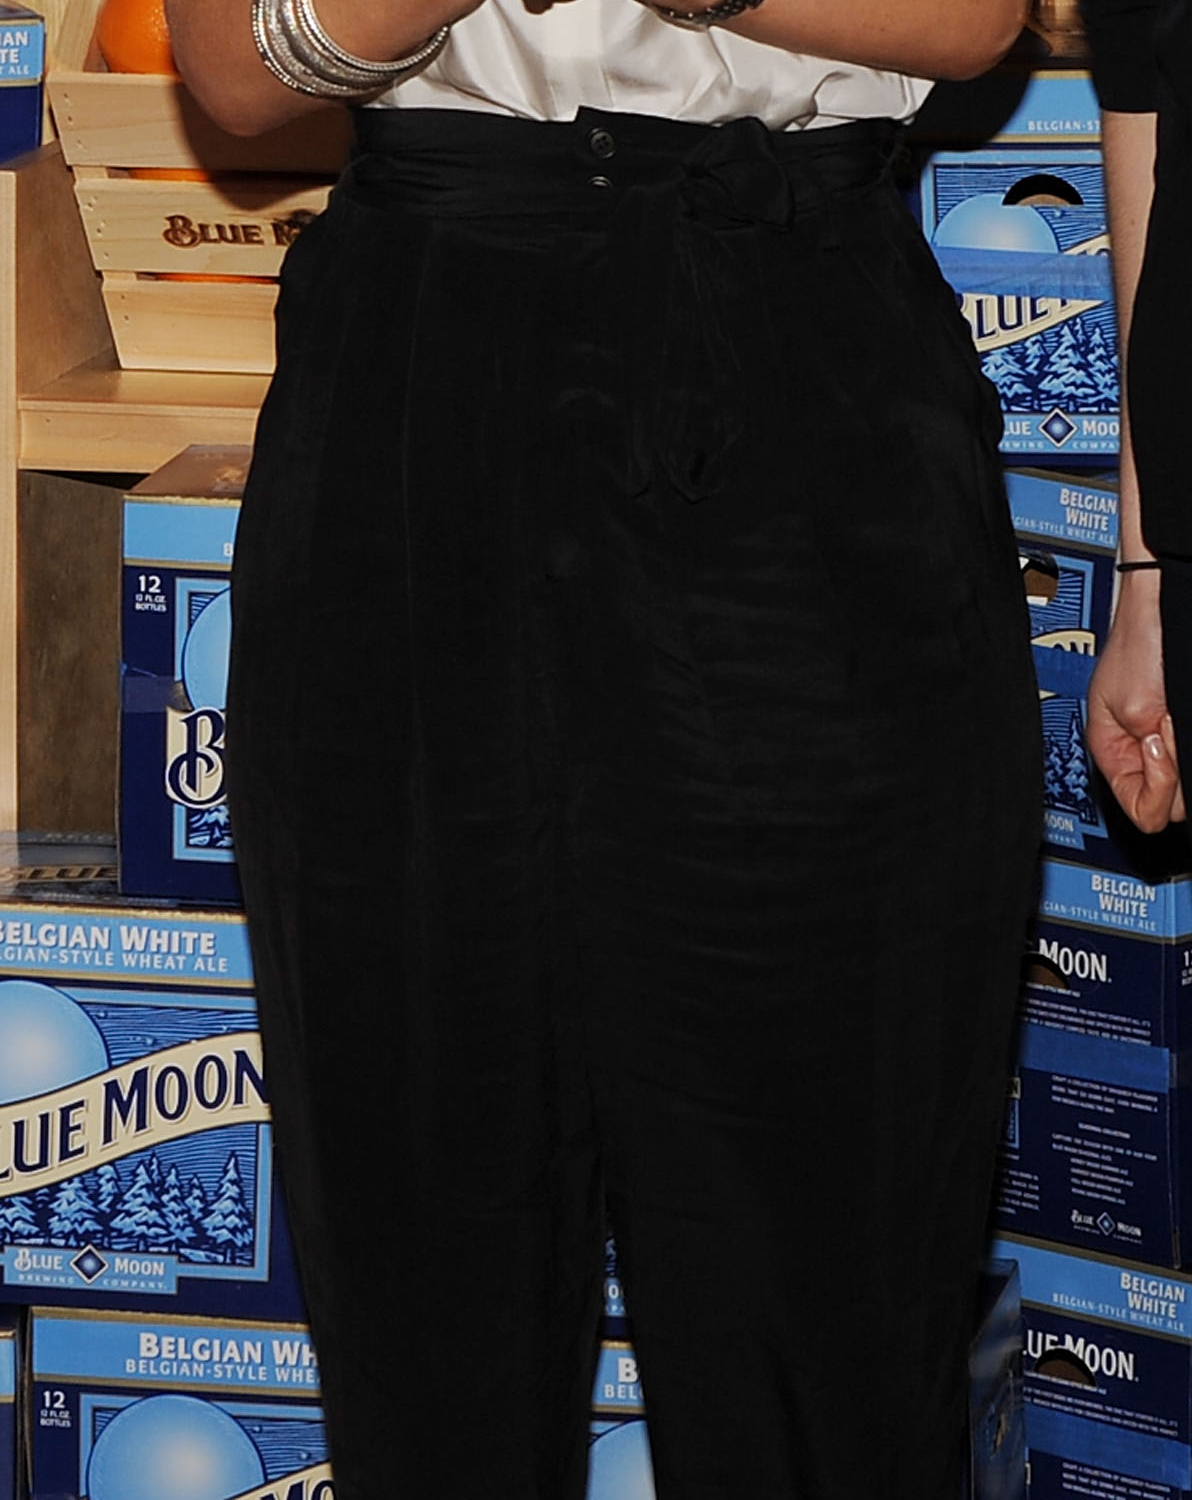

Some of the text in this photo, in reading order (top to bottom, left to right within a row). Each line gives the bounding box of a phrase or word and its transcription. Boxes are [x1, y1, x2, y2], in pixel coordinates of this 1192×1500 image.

[1027, 119, 1100, 132] BELGIAN-ST
[164, 214, 263, 248] BLUE
[975, 295, 1049, 340] LUE
[1083, 420, 1119, 436] MOO
[1060, 488, 1117, 514] BELGIAN
[1015, 516, 1064, 535] GIAN-STYLE
[1066, 508, 1109, 531] WHITE
[139, 575, 161, 593] 12
[1091, 874, 1156, 902] BELGIAN
[1044, 901, 1099, 920] GIAN-STYLE
[1099, 893, 1148, 918] WHITE
[120, 925, 216, 955] WHITE
[0, 946, 228, 973] GIAN-STYLE WHEAT ALE
[0, 1049, 269, 1178] UE MOON
[14, 1247, 164, 1276] BLUE MOON
[18, 1274, 75, 1285] BREWING
[1120, 1273, 1186, 1303] BELGIAN
[1128, 1291, 1177, 1319] WHITE
[140, 1332, 262, 1365] BELGIAN
[125, 1358, 316, 1383] BELGIAN-STYLE WHE
[43, 1391, 65, 1408] 12
